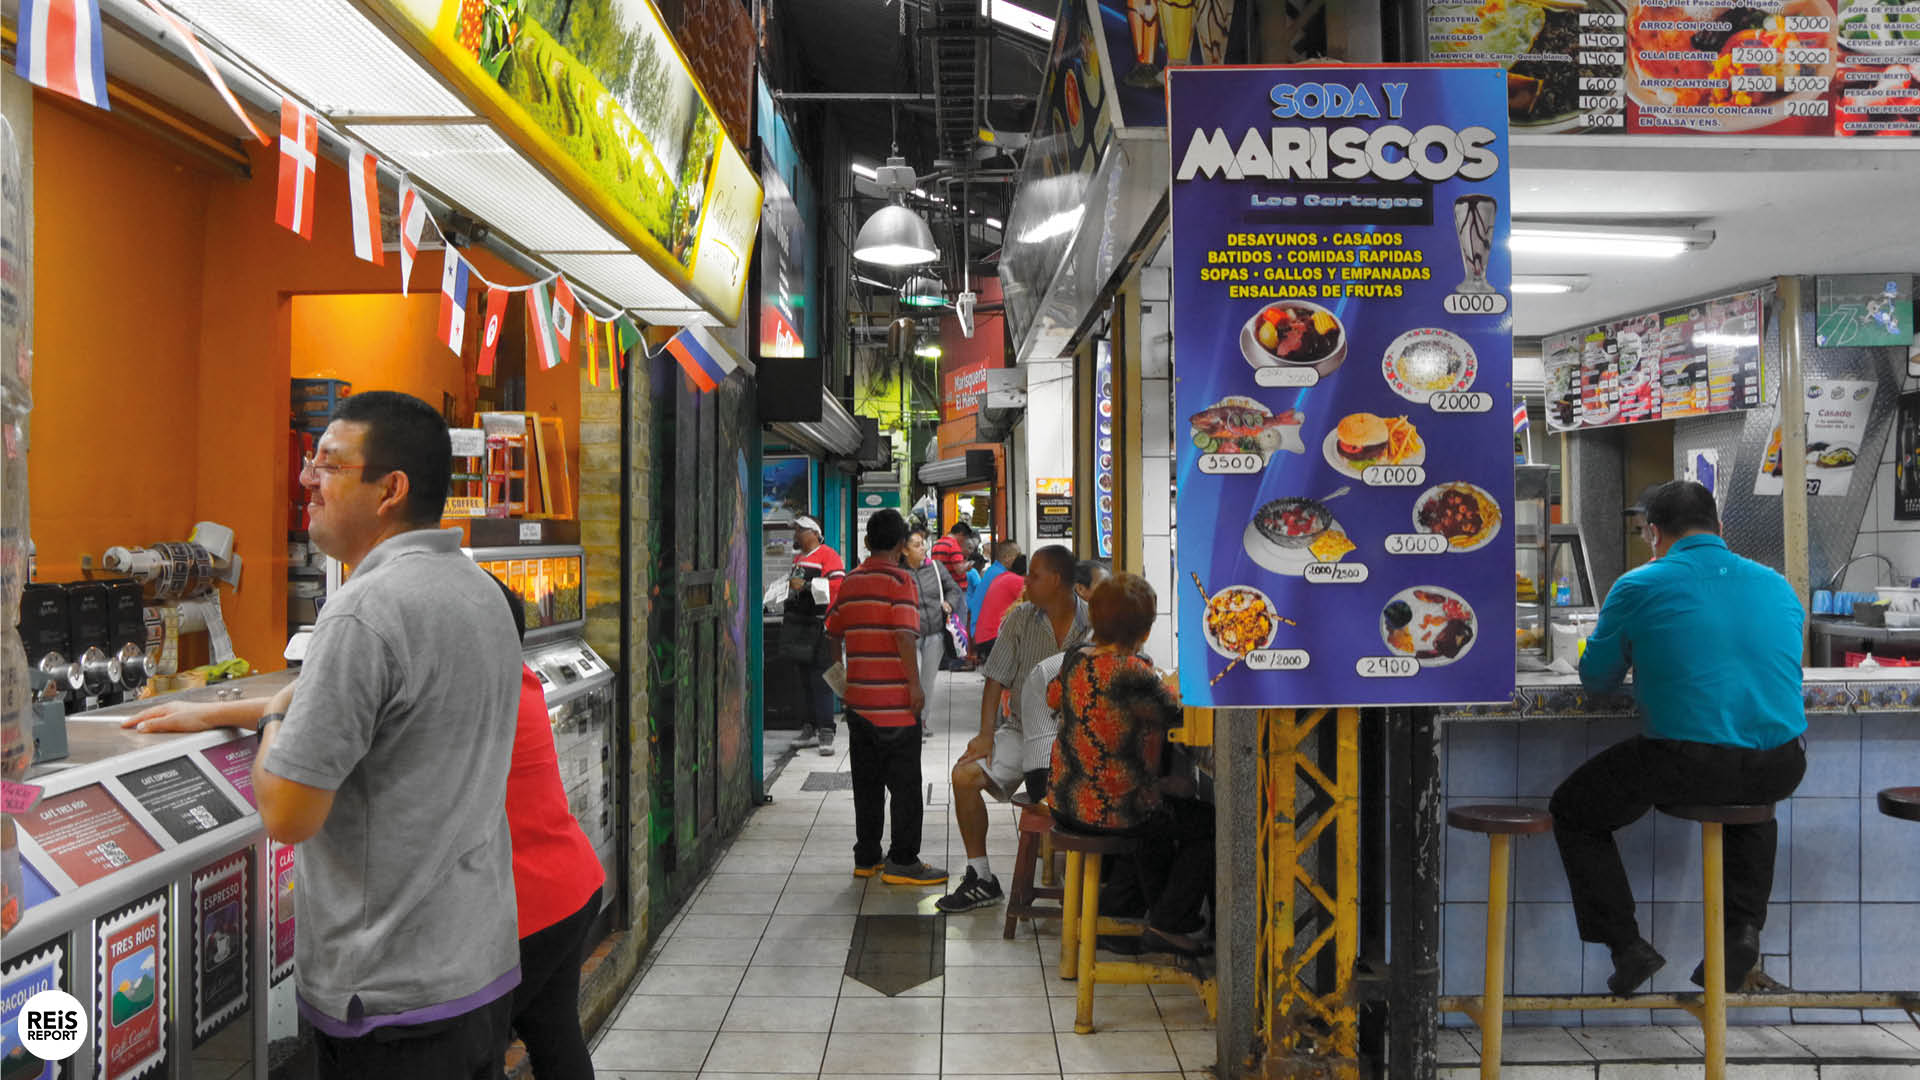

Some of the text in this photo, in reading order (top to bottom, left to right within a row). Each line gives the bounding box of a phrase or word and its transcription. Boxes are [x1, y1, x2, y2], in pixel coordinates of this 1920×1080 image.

[1588, 15, 1616, 27] 600
[1640, 22, 1732, 31] ARROZ CON POLLO
[1789, 17, 1829, 31] 3000
[1584, 35, 1619, 47] 1400
[1490, 53, 1515, 61] Carne,
[1584, 53, 1616, 65] 1400
[1640, 52, 1717, 60] OLLA DE CARNE
[1736, 48, 1774, 62] 2500
[1788, 50, 1827, 64] 3000
[1587, 78, 1616, 90] 600
[1640, 79, 1728, 88] ARROZ CANTONES
[1737, 77, 1773, 91] 2500
[1790, 78, 1827, 91] 3000
[1270, 82, 1409, 119] SODA Y
[1583, 96, 1619, 109] 1000
[1640, 106, 1773, 115] ARROZ BLANCO CON CARNE
[1789, 102, 1828, 116] 2000
[1588, 114, 1615, 127] 800
[1656, 119, 1687, 127] SALSA
[1690, 119, 1696, 127] Y
[1698, 119, 1721, 127] ENS.
[1176, 125, 1499, 181] MARISCOS
[1227, 233, 1403, 246] DESAYUNOS CASADOS
[1208, 251, 1423, 264] BATIDOS COMIDAS RAPIDAS
[1200, 268, 1431, 281] SOPAS GALLOS Y EMPANADAS
[1229, 285, 1403, 298] ENSALADAS DE FRUTAS
[1451, 294, 1495, 313] 1000
[1437, 393, 1481, 410] 2000
[1818, 409, 1852, 418] Casado
[1207, 457, 1256, 470] 3500
[1371, 467, 1418, 484] 2000
[1391, 536, 1441, 552] 3000
[1366, 658, 1411, 674] 2900
[204, 882, 240, 910] ESPRESSO
[110, 923, 156, 959] TRES RÍOS
